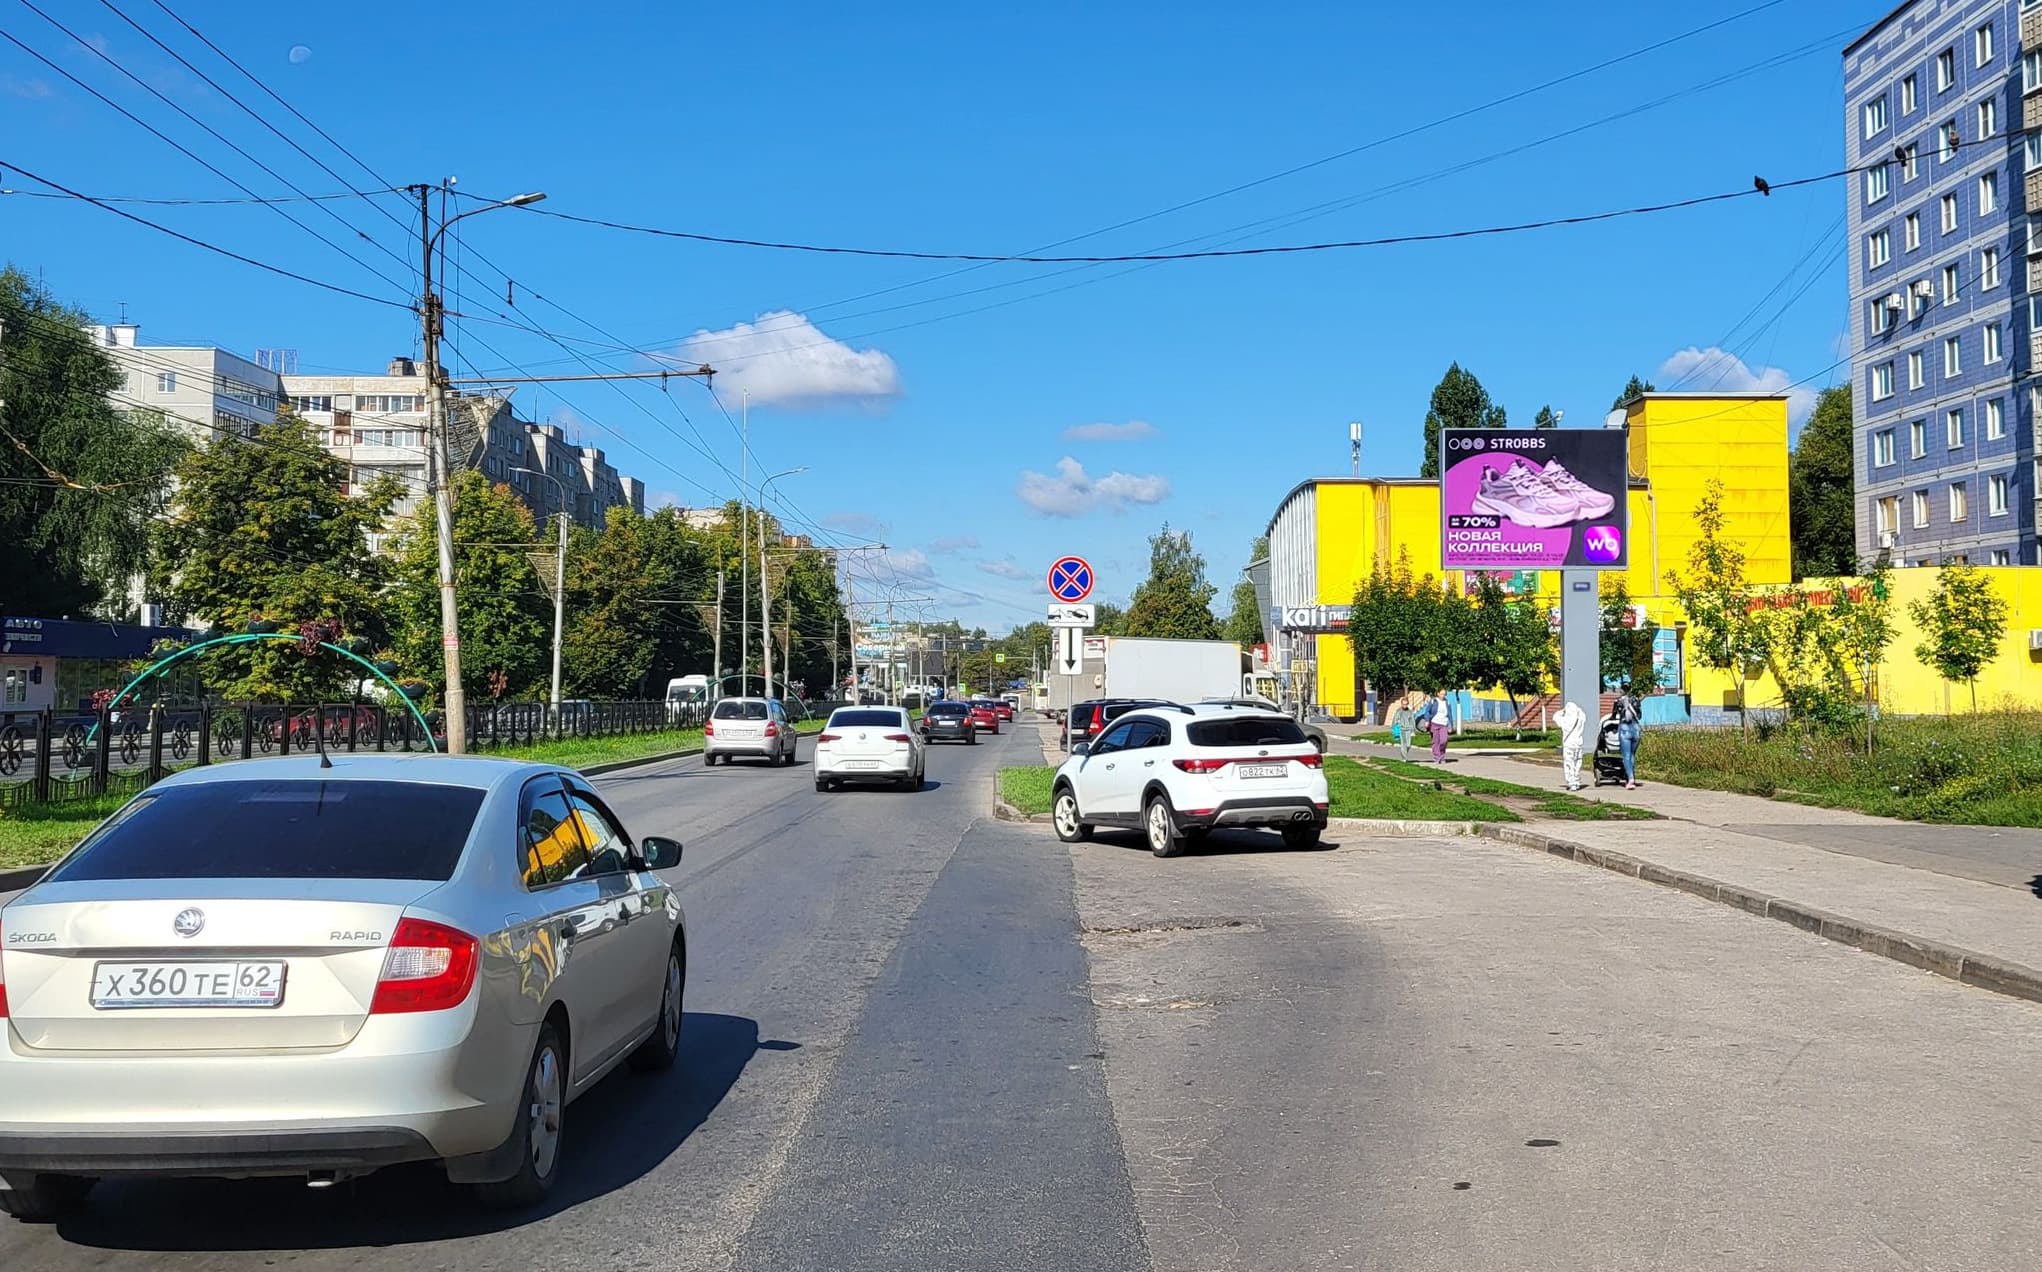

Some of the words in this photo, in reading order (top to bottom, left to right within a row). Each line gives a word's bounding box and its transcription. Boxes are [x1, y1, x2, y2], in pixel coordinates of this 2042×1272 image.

[1490, 438, 1546, 449] STROBBS
[1448, 531, 1501, 541] НОВАЯ
[1448, 543, 1543, 553] КОЛЛЕКЦИЯ
[1282, 604, 1327, 627] kari
[4, 619, 43, 629] АВТО
[330, 931, 382, 941] RAPID
[239, 965, 271, 988] 62
[236, 988, 259, 997] RUS
